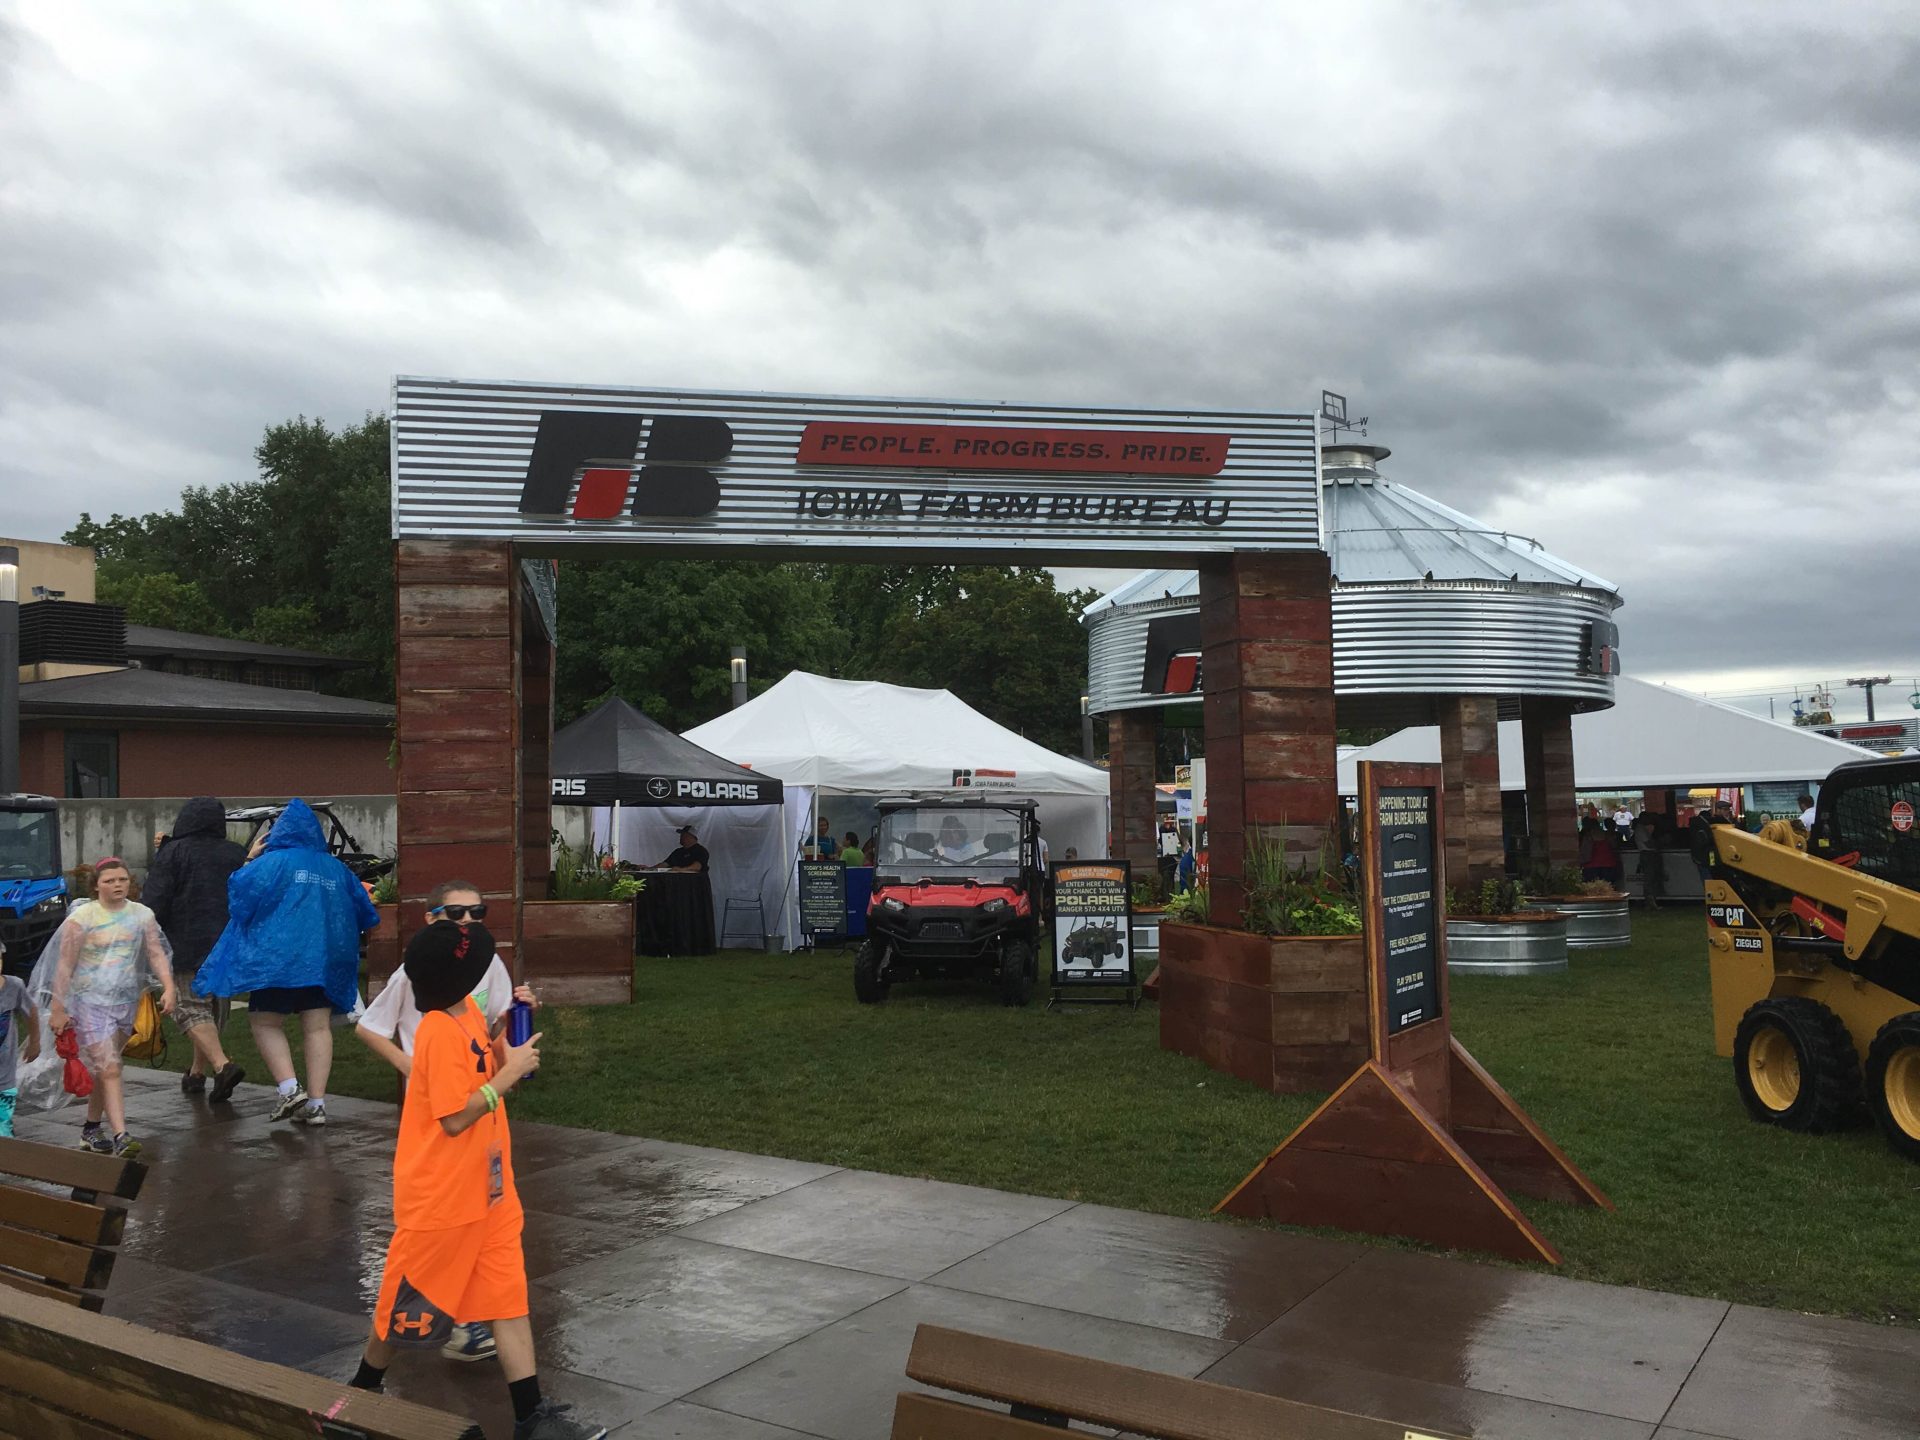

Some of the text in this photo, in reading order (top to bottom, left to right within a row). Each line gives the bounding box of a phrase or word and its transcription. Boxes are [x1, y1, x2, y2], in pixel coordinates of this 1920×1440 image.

[1360, 416, 1368, 426] W
[1361, 428, 1368, 437] S
[820, 434, 1212, 463] PEOPLE. PROGRESS. PRIDE.
[798, 490, 1231, 526] IOWA FARM BUREAU
[676, 780, 759, 800] POLARIS
[975, 780, 987, 788] IOWA
[999, 781, 1016, 789] BUREAU
[1407, 796, 1421, 809] TODAY
[1422, 796, 1429, 809] AT
[1380, 811, 1427, 826] FARM BUREAU PARK
[1056, 895, 1125, 905] POLARIS
[1726, 907, 1745, 927] CAT
[1735, 938, 1762, 949] ZIEGLER
